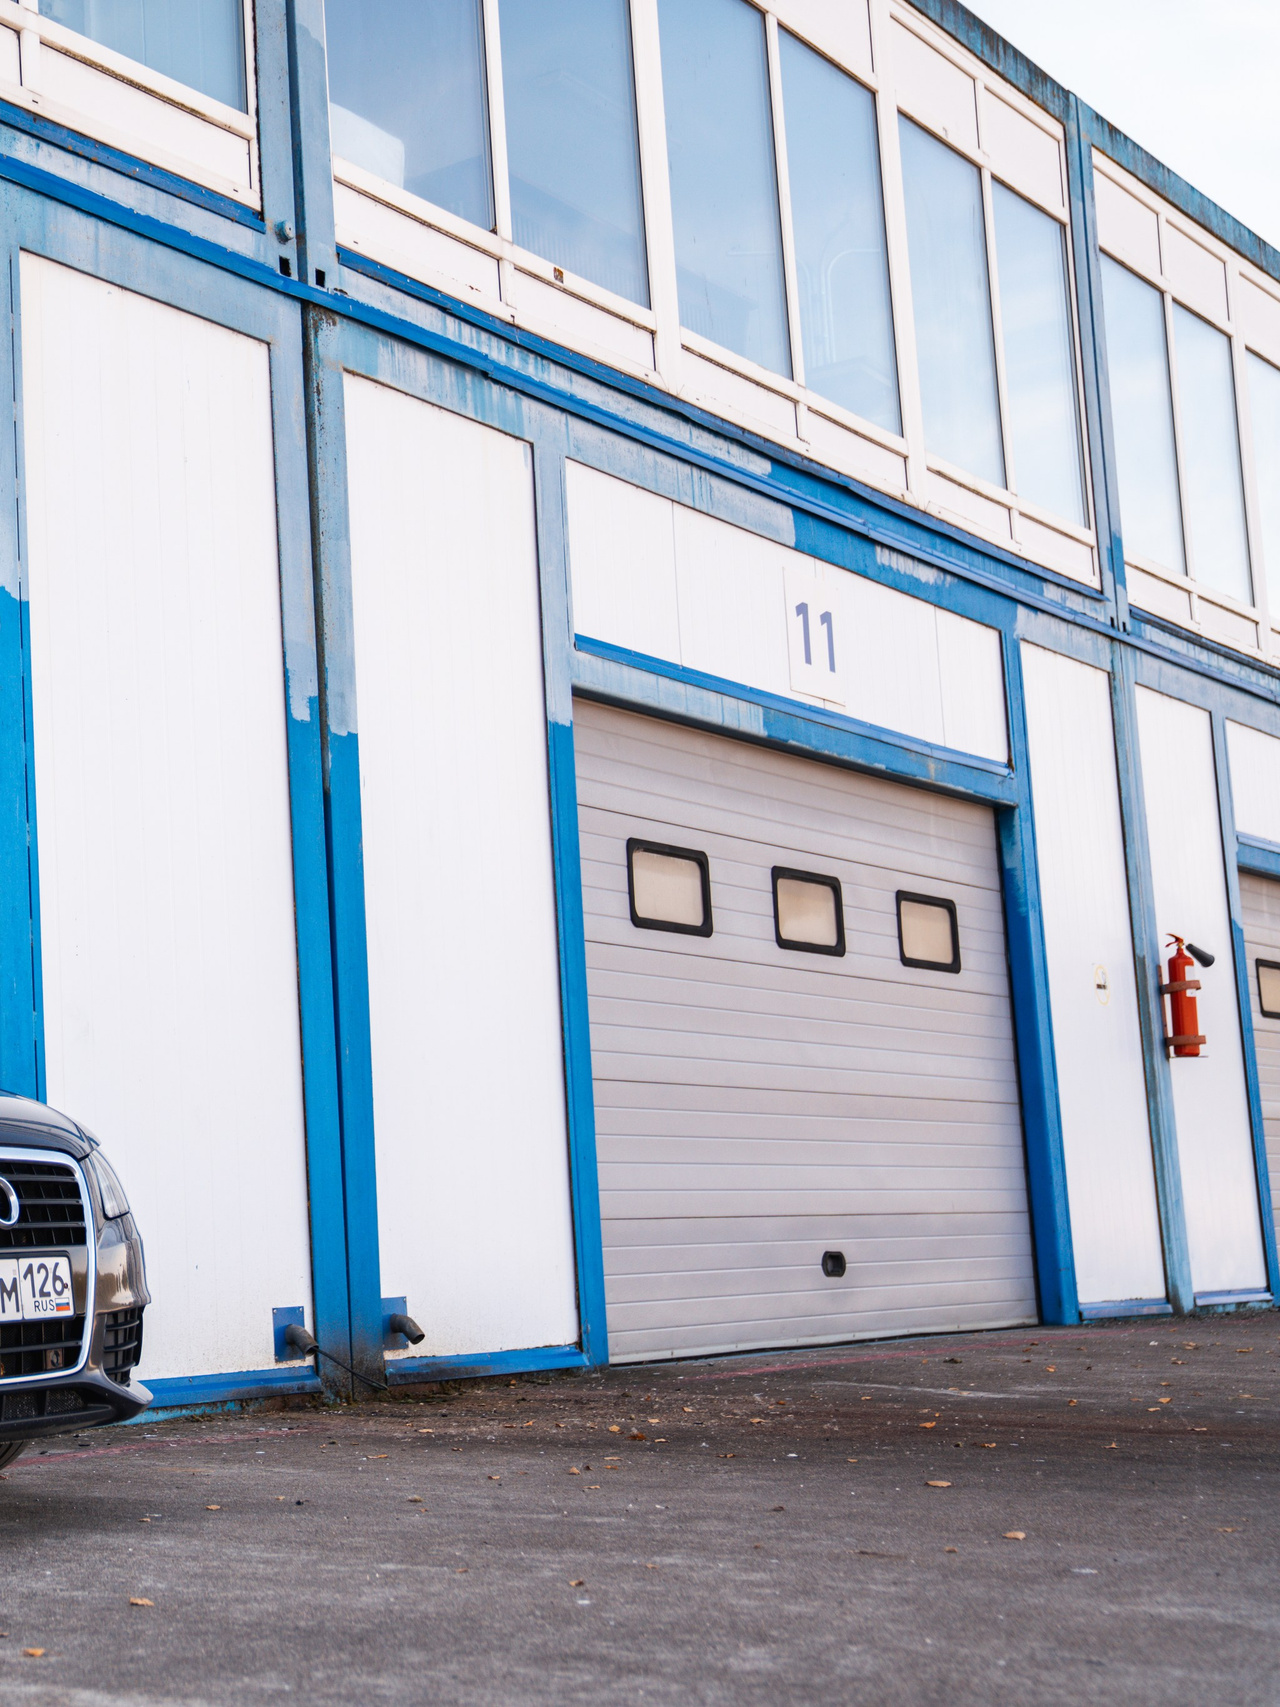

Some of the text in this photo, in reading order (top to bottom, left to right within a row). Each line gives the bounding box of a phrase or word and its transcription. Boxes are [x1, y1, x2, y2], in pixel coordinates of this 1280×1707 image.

[795, 601, 836, 673] 11
[23, 1262, 65, 1298] 126
[34, 1300, 56, 1312] RUS
